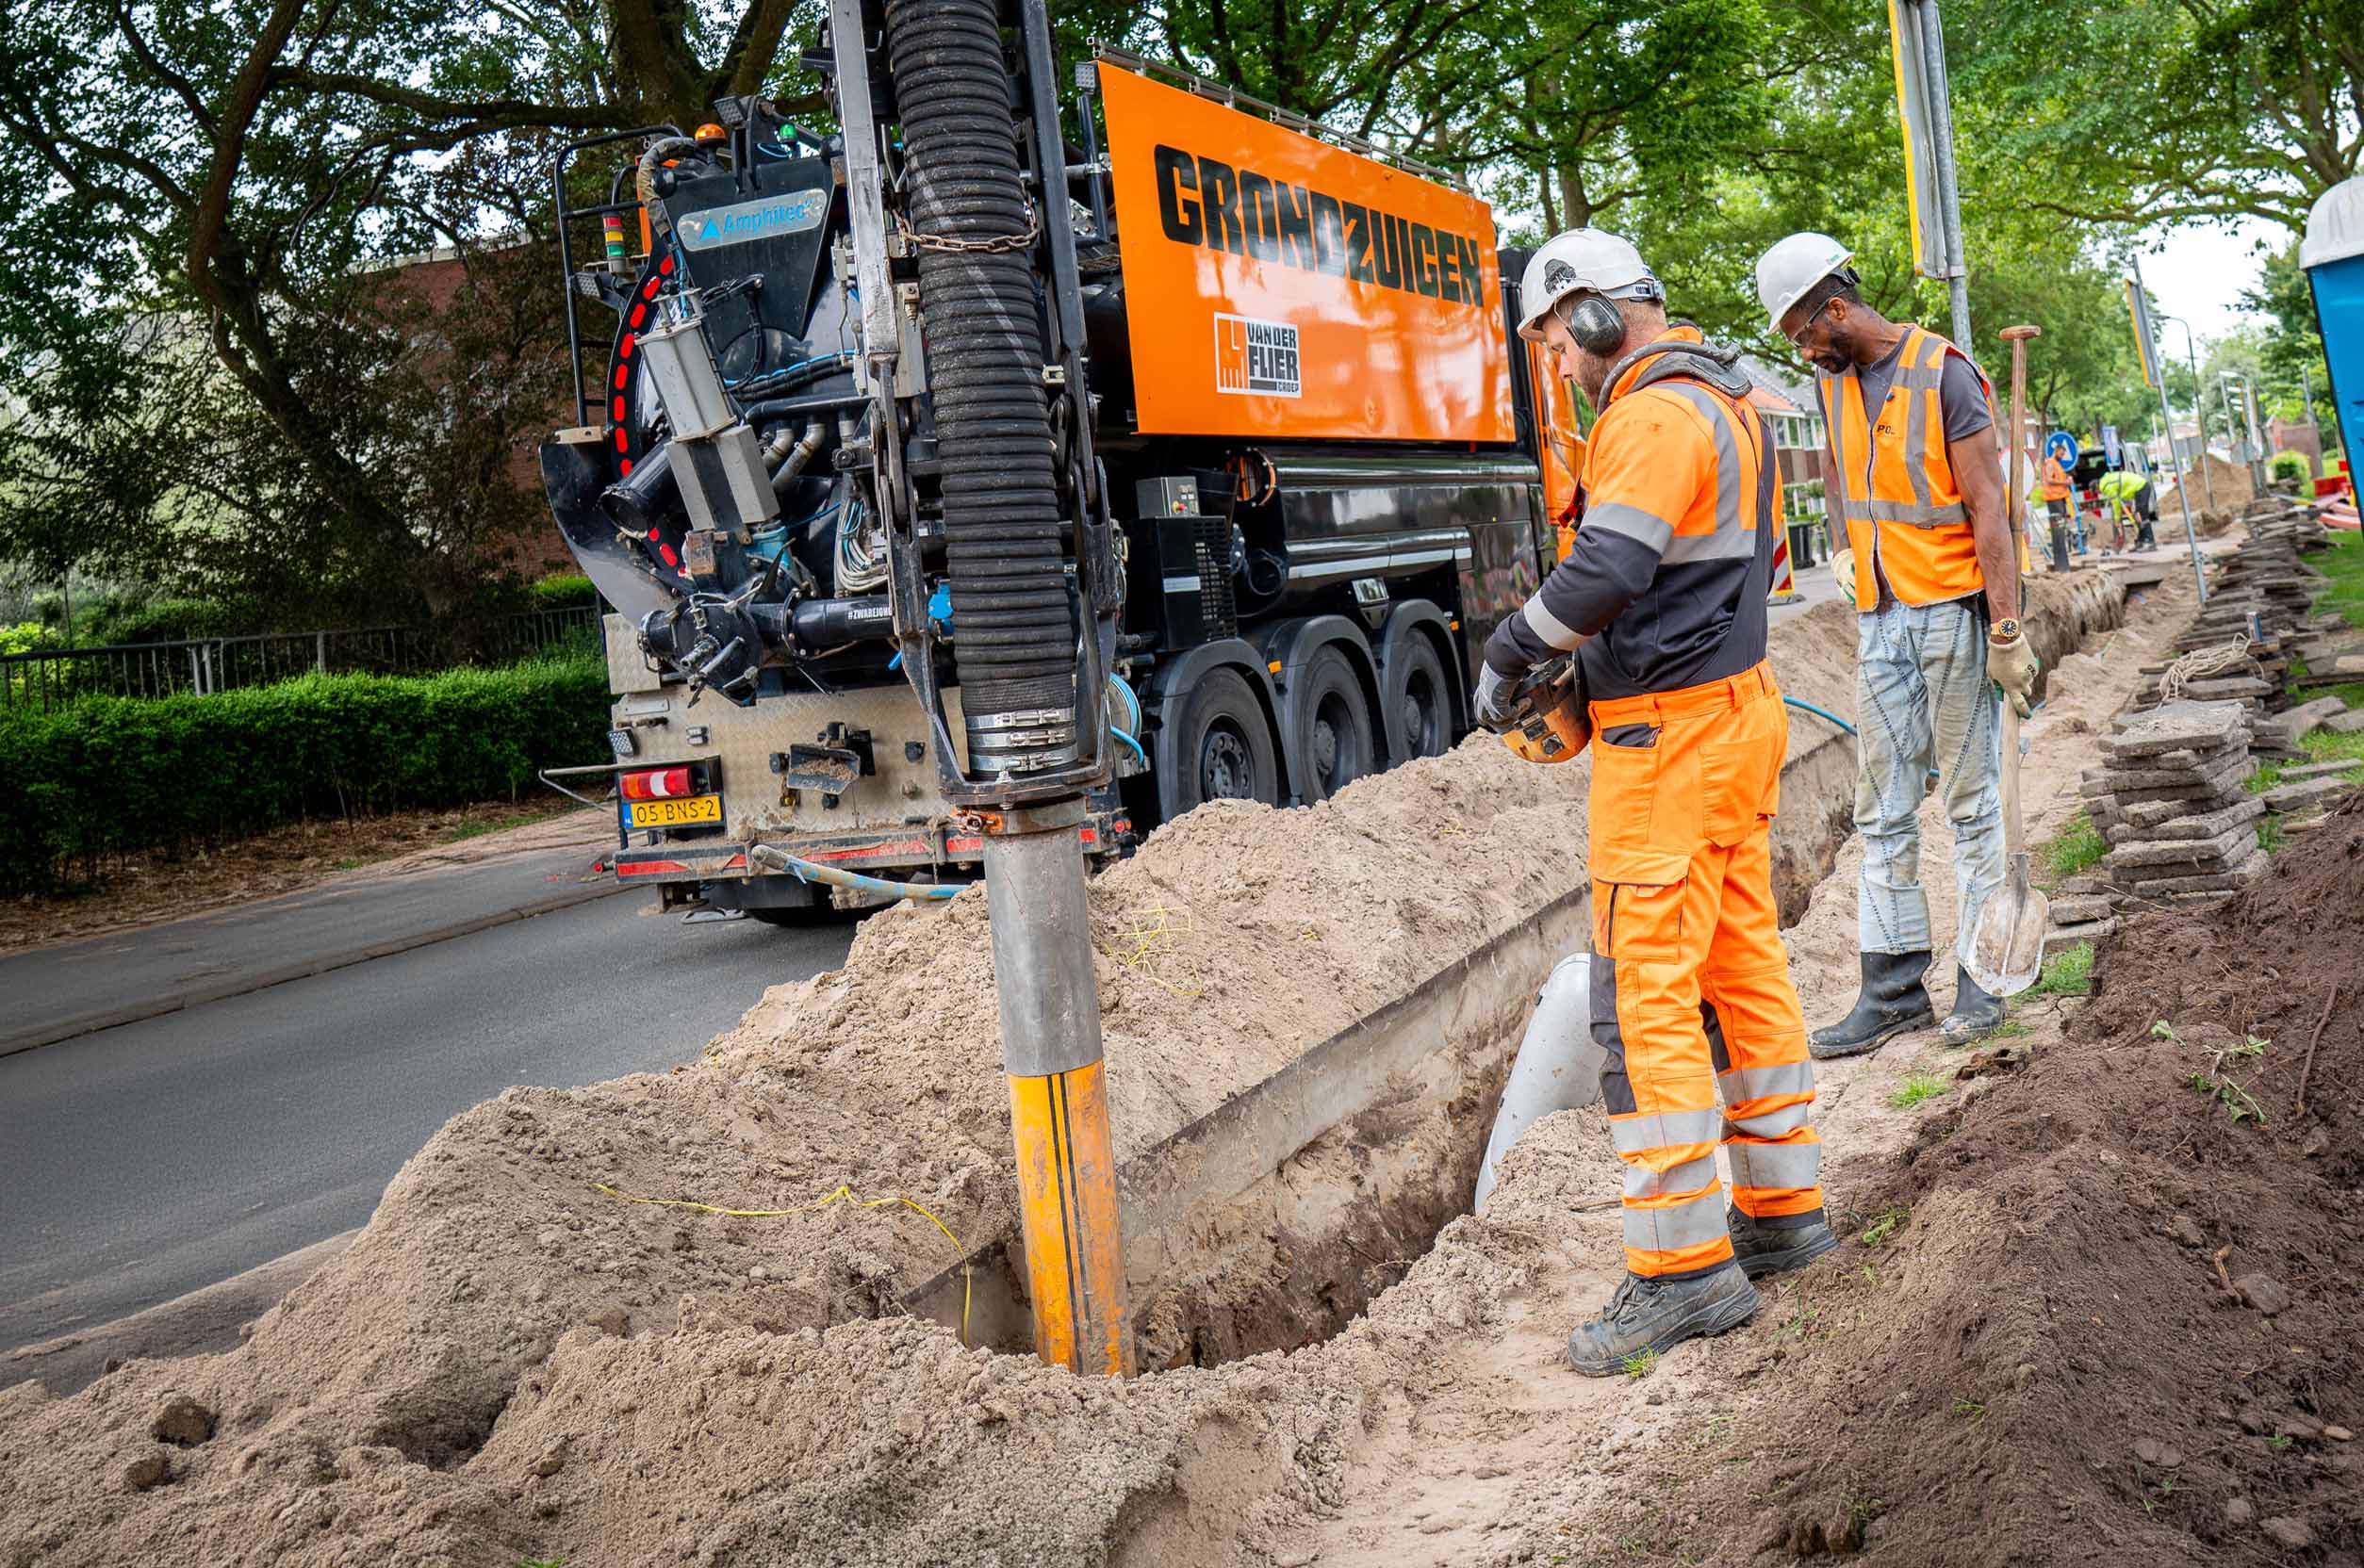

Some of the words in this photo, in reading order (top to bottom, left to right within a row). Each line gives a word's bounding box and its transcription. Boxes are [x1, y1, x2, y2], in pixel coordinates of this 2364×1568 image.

[724, 204, 808, 235] Amphitec
[1154, 143, 1485, 308] GRONDZUIGEN
[1248, 345, 1299, 382] FLIER
[1277, 382, 1299, 393] GROEP
[636, 799, 715, 823] 05-BNS-2
